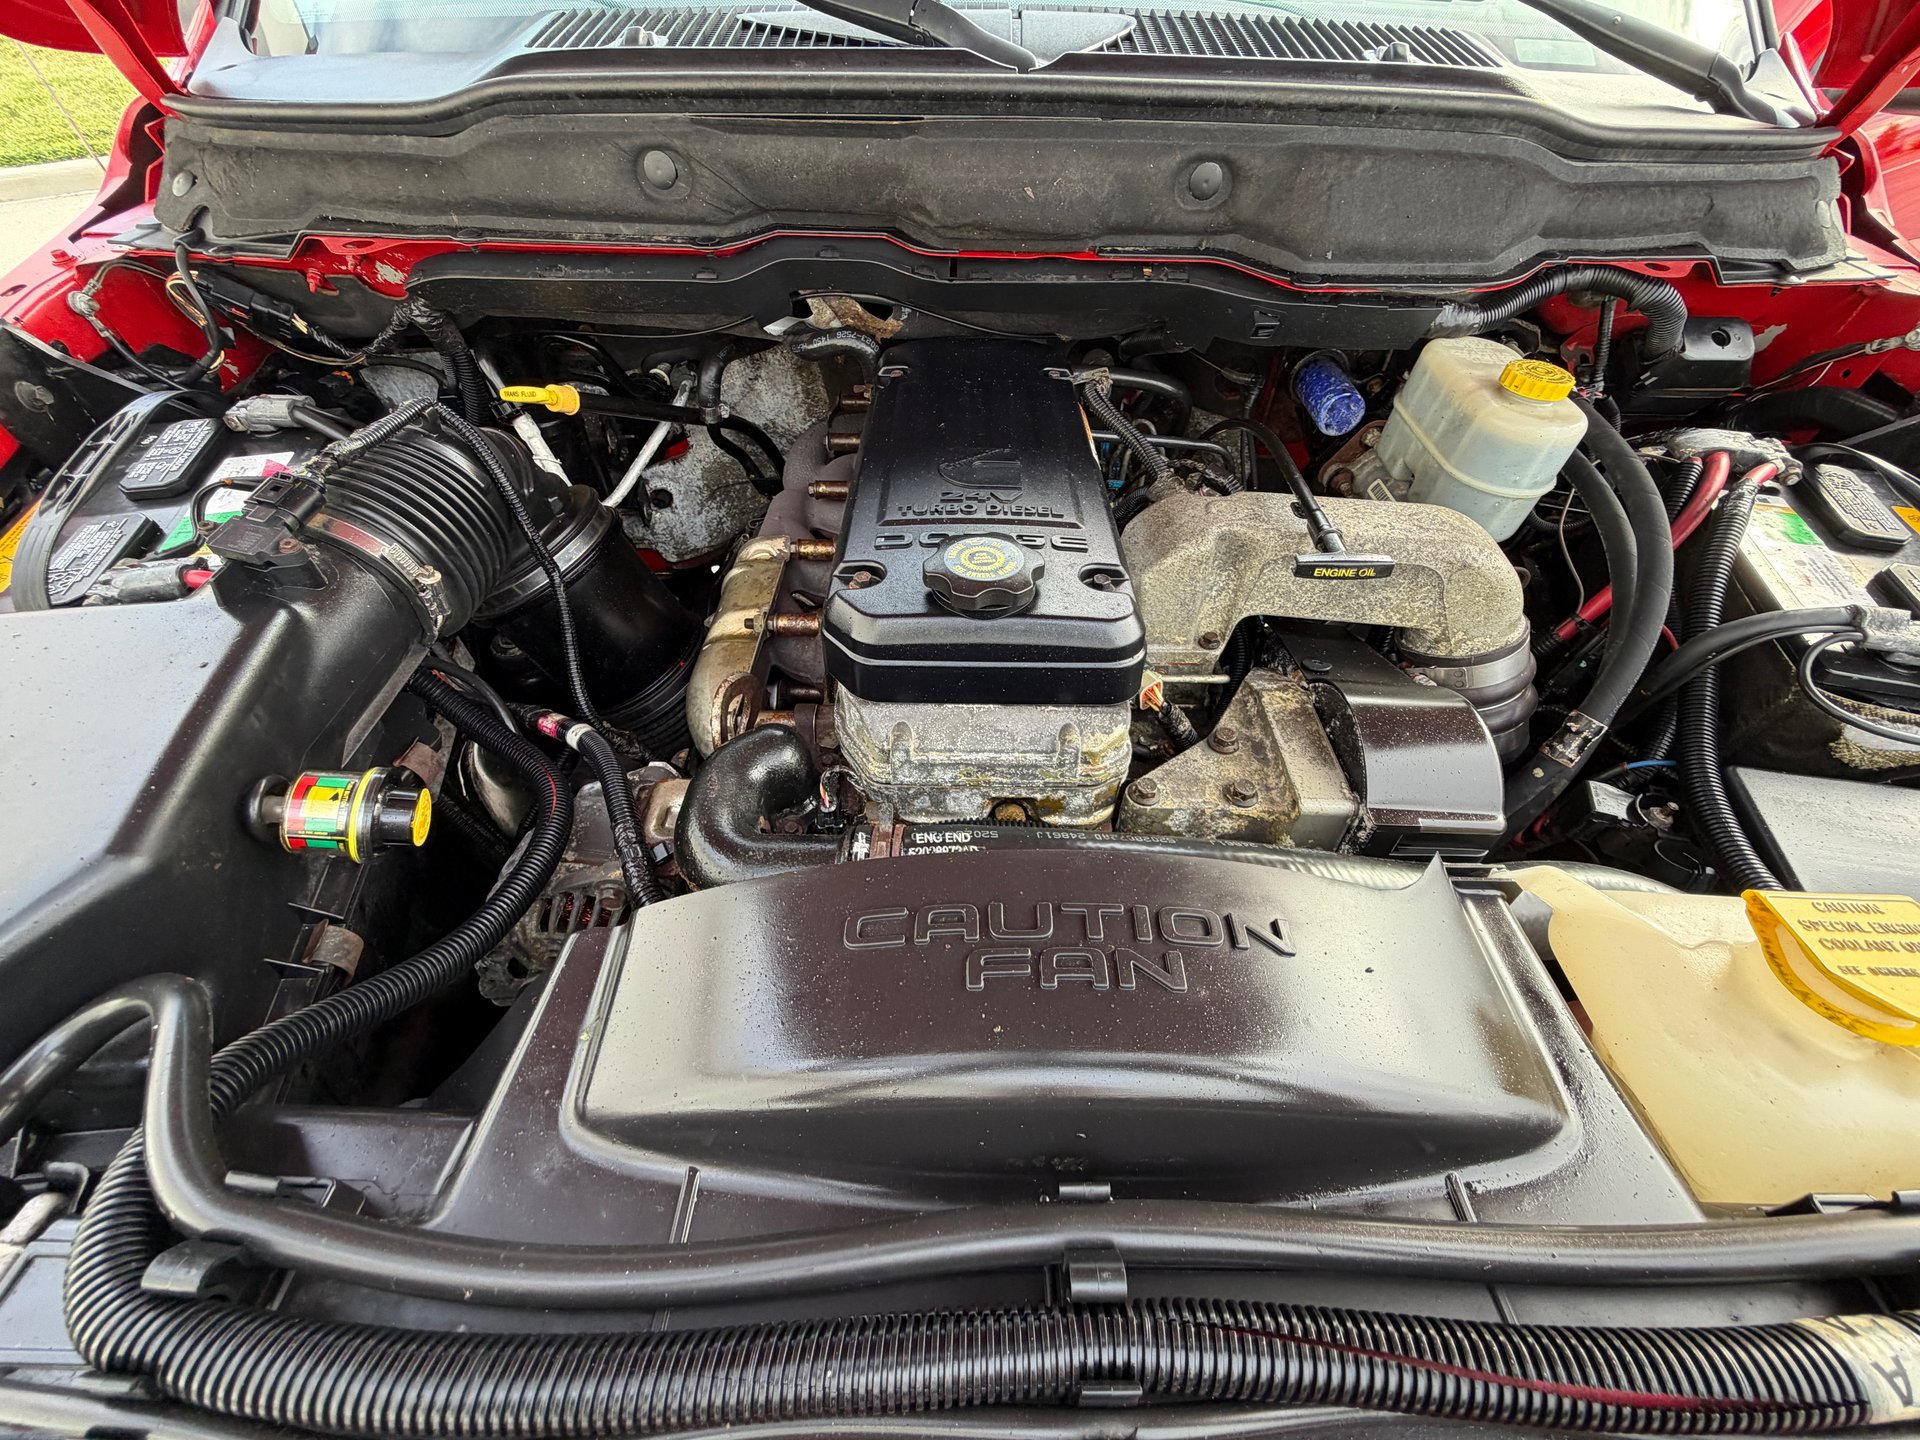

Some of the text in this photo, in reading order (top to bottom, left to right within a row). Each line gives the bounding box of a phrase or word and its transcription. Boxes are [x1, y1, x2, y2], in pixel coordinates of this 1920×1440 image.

[503, 390, 537, 398] TRANS FLUID
[897, 503, 1065, 519] TURBO DIESEL
[873, 531, 1089, 554] DOGE
[1313, 567, 1377, 577] ENGINE OIL
[915, 832, 971, 844] ENG END
[1811, 901, 1886, 915] CAUTION
[843, 901, 1298, 957] CAUTION
[1797, 918, 1873, 934] SPECIAL
[1818, 937, 1900, 953] COOLANT
[965, 946, 1188, 993] FAN
[1837, 964, 1867, 976] SEE
